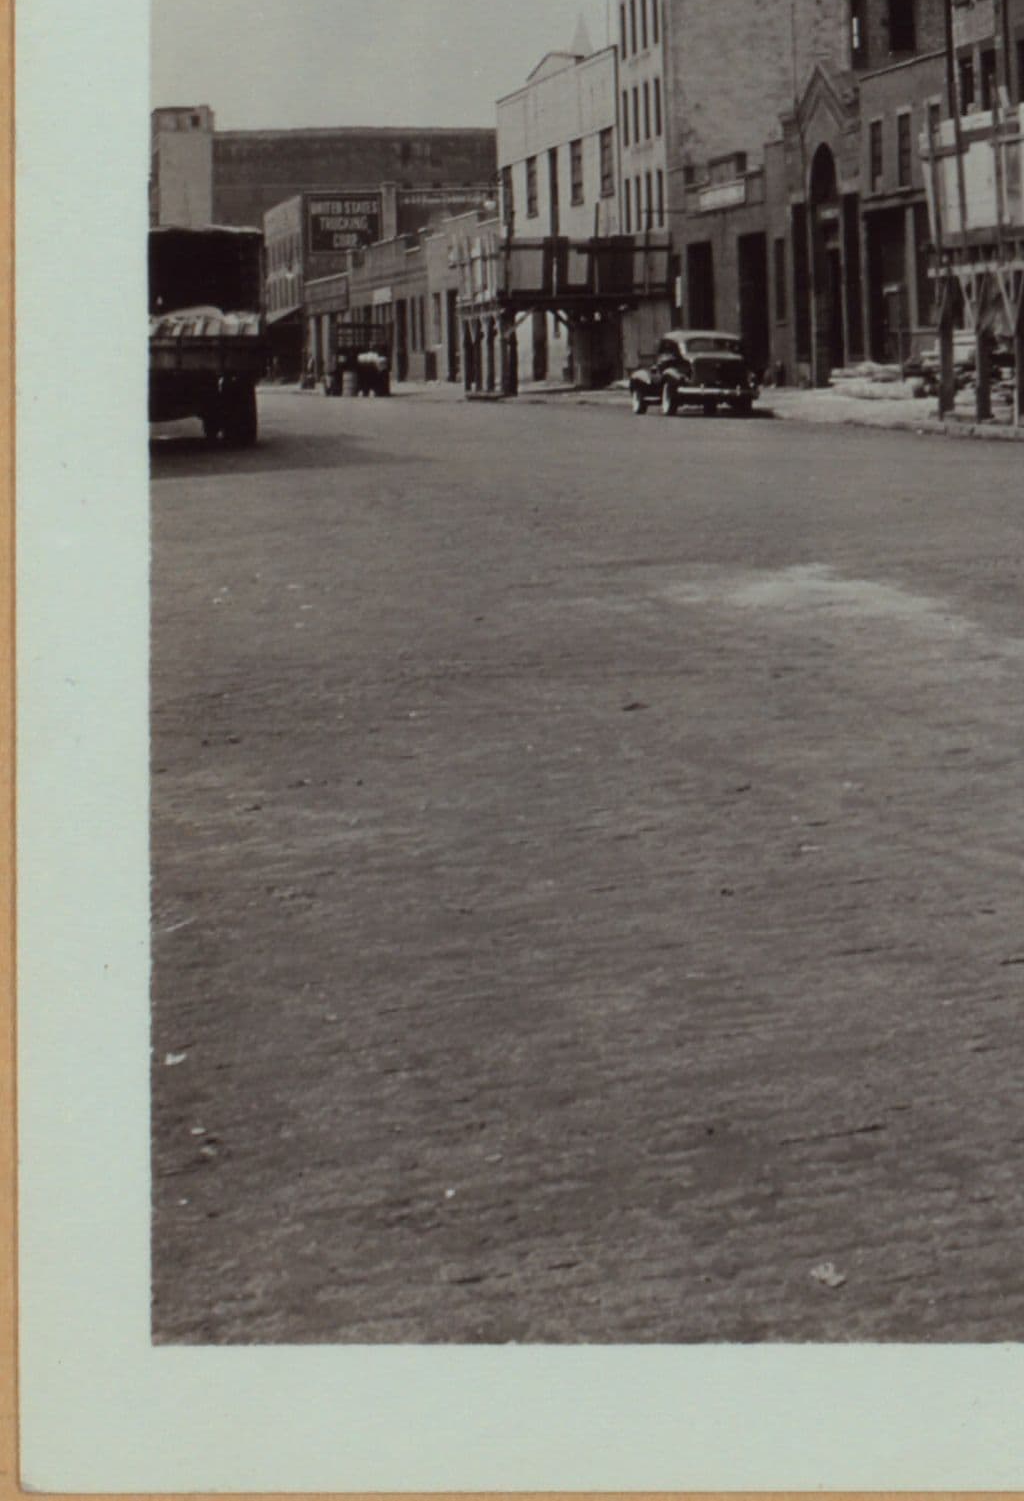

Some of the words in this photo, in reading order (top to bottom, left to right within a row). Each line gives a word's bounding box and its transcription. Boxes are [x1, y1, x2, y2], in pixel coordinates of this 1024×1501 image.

[311, 201, 342, 215] UNITED
[344, 201, 377, 214] STATES
[319, 216, 367, 231] TRUCKING
